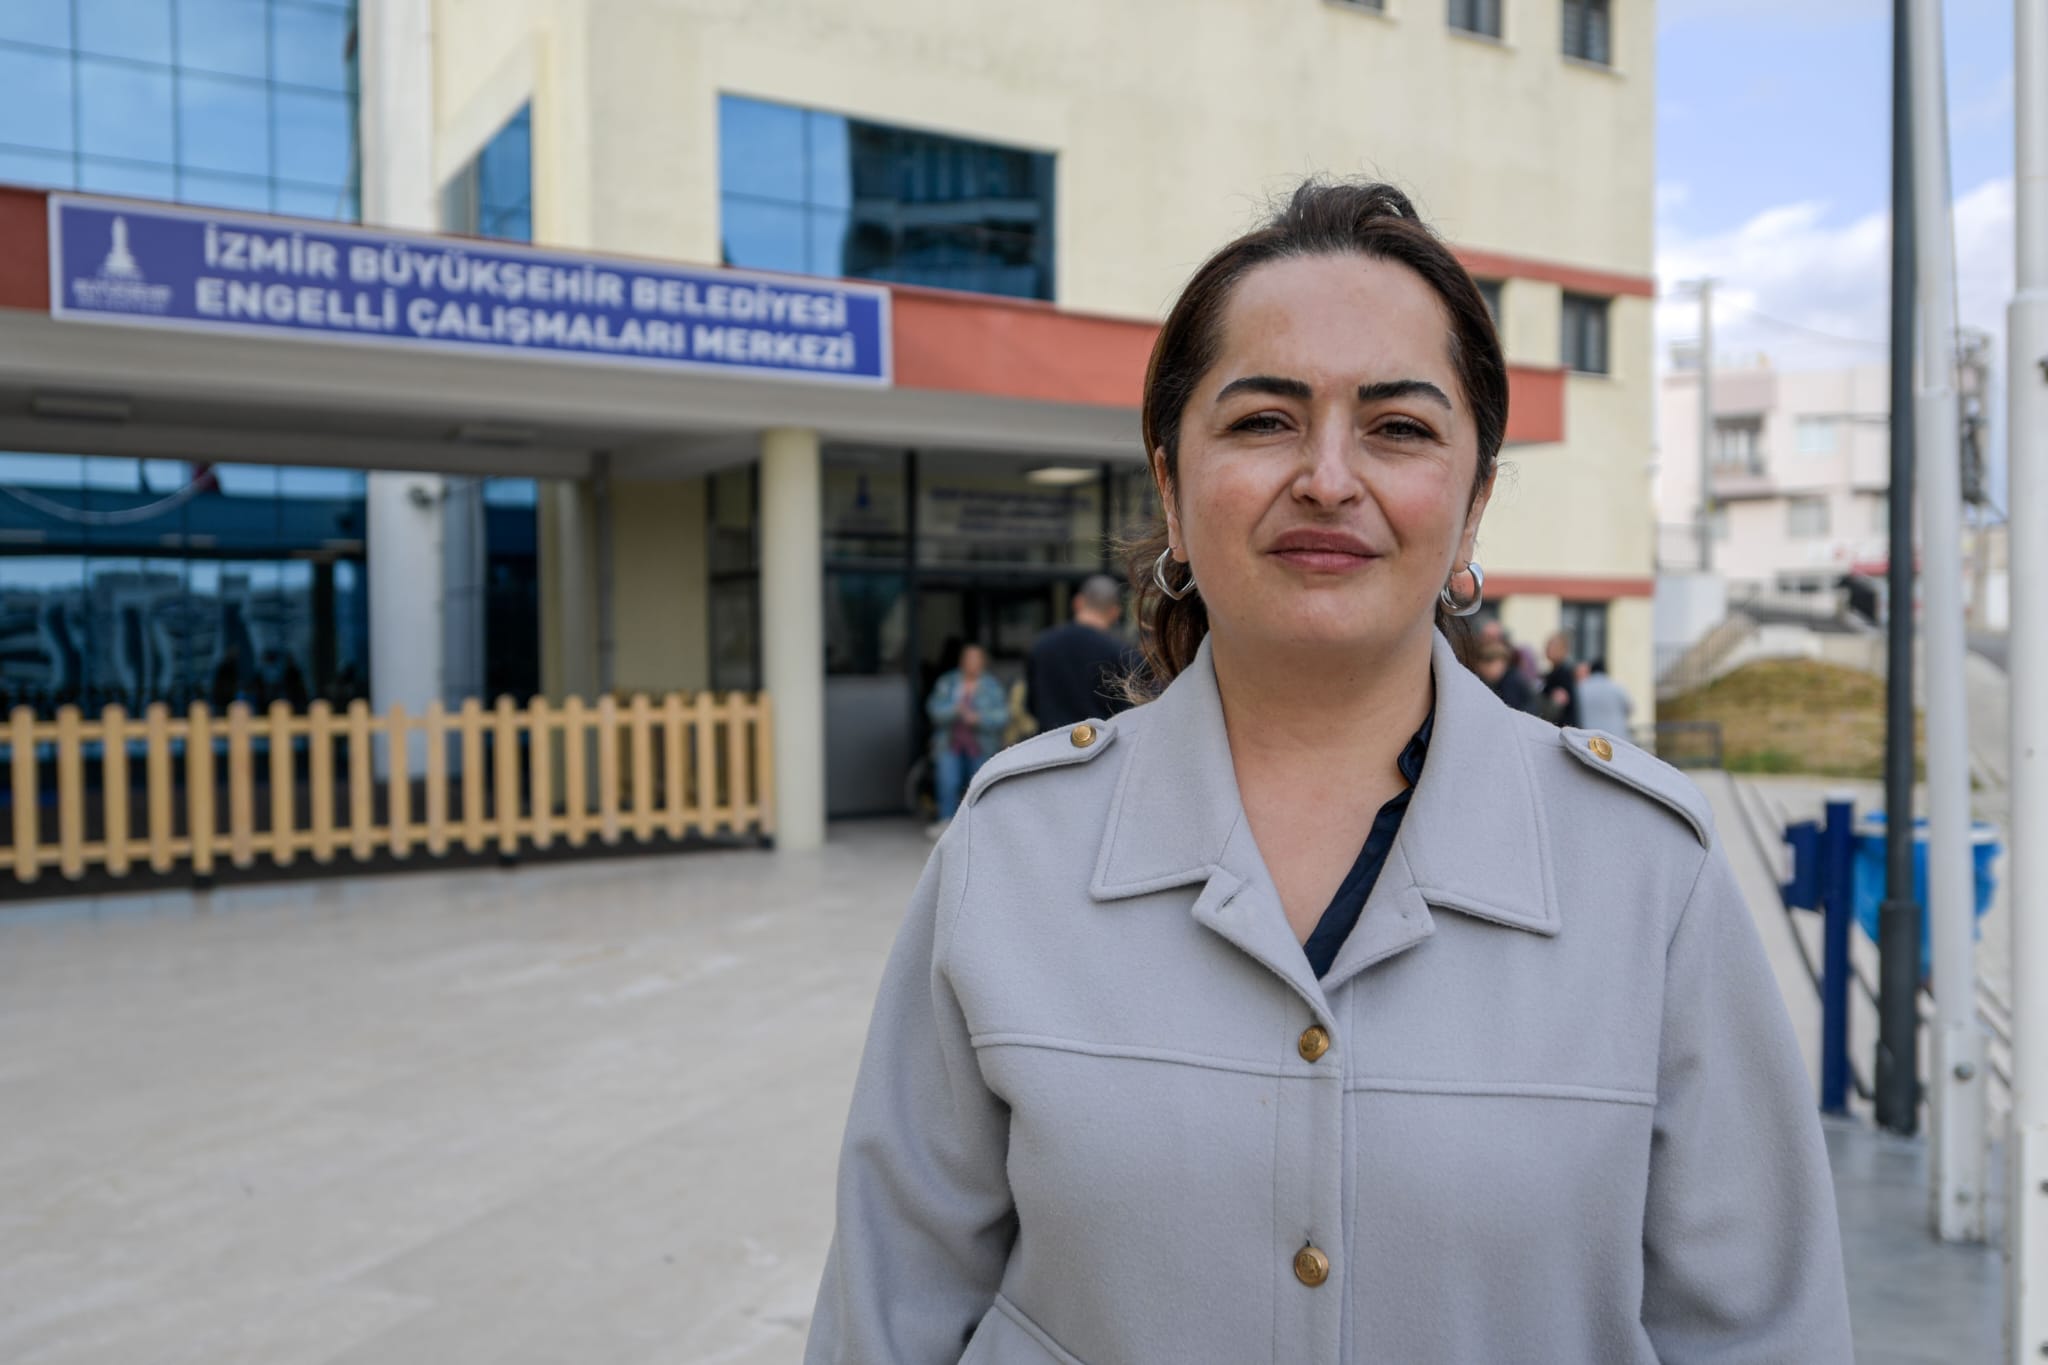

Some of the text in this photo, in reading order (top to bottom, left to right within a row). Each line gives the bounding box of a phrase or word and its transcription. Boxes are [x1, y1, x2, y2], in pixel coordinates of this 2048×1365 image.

[196, 278, 397, 330] ENGELLİ
[406, 297, 686, 354] ÇALIŞMALARI
[693, 324, 856, 370] MERKEZİ
[204, 223, 848, 329] İZMİR BÜYÜKŞEHİR BELEDİYESİ
